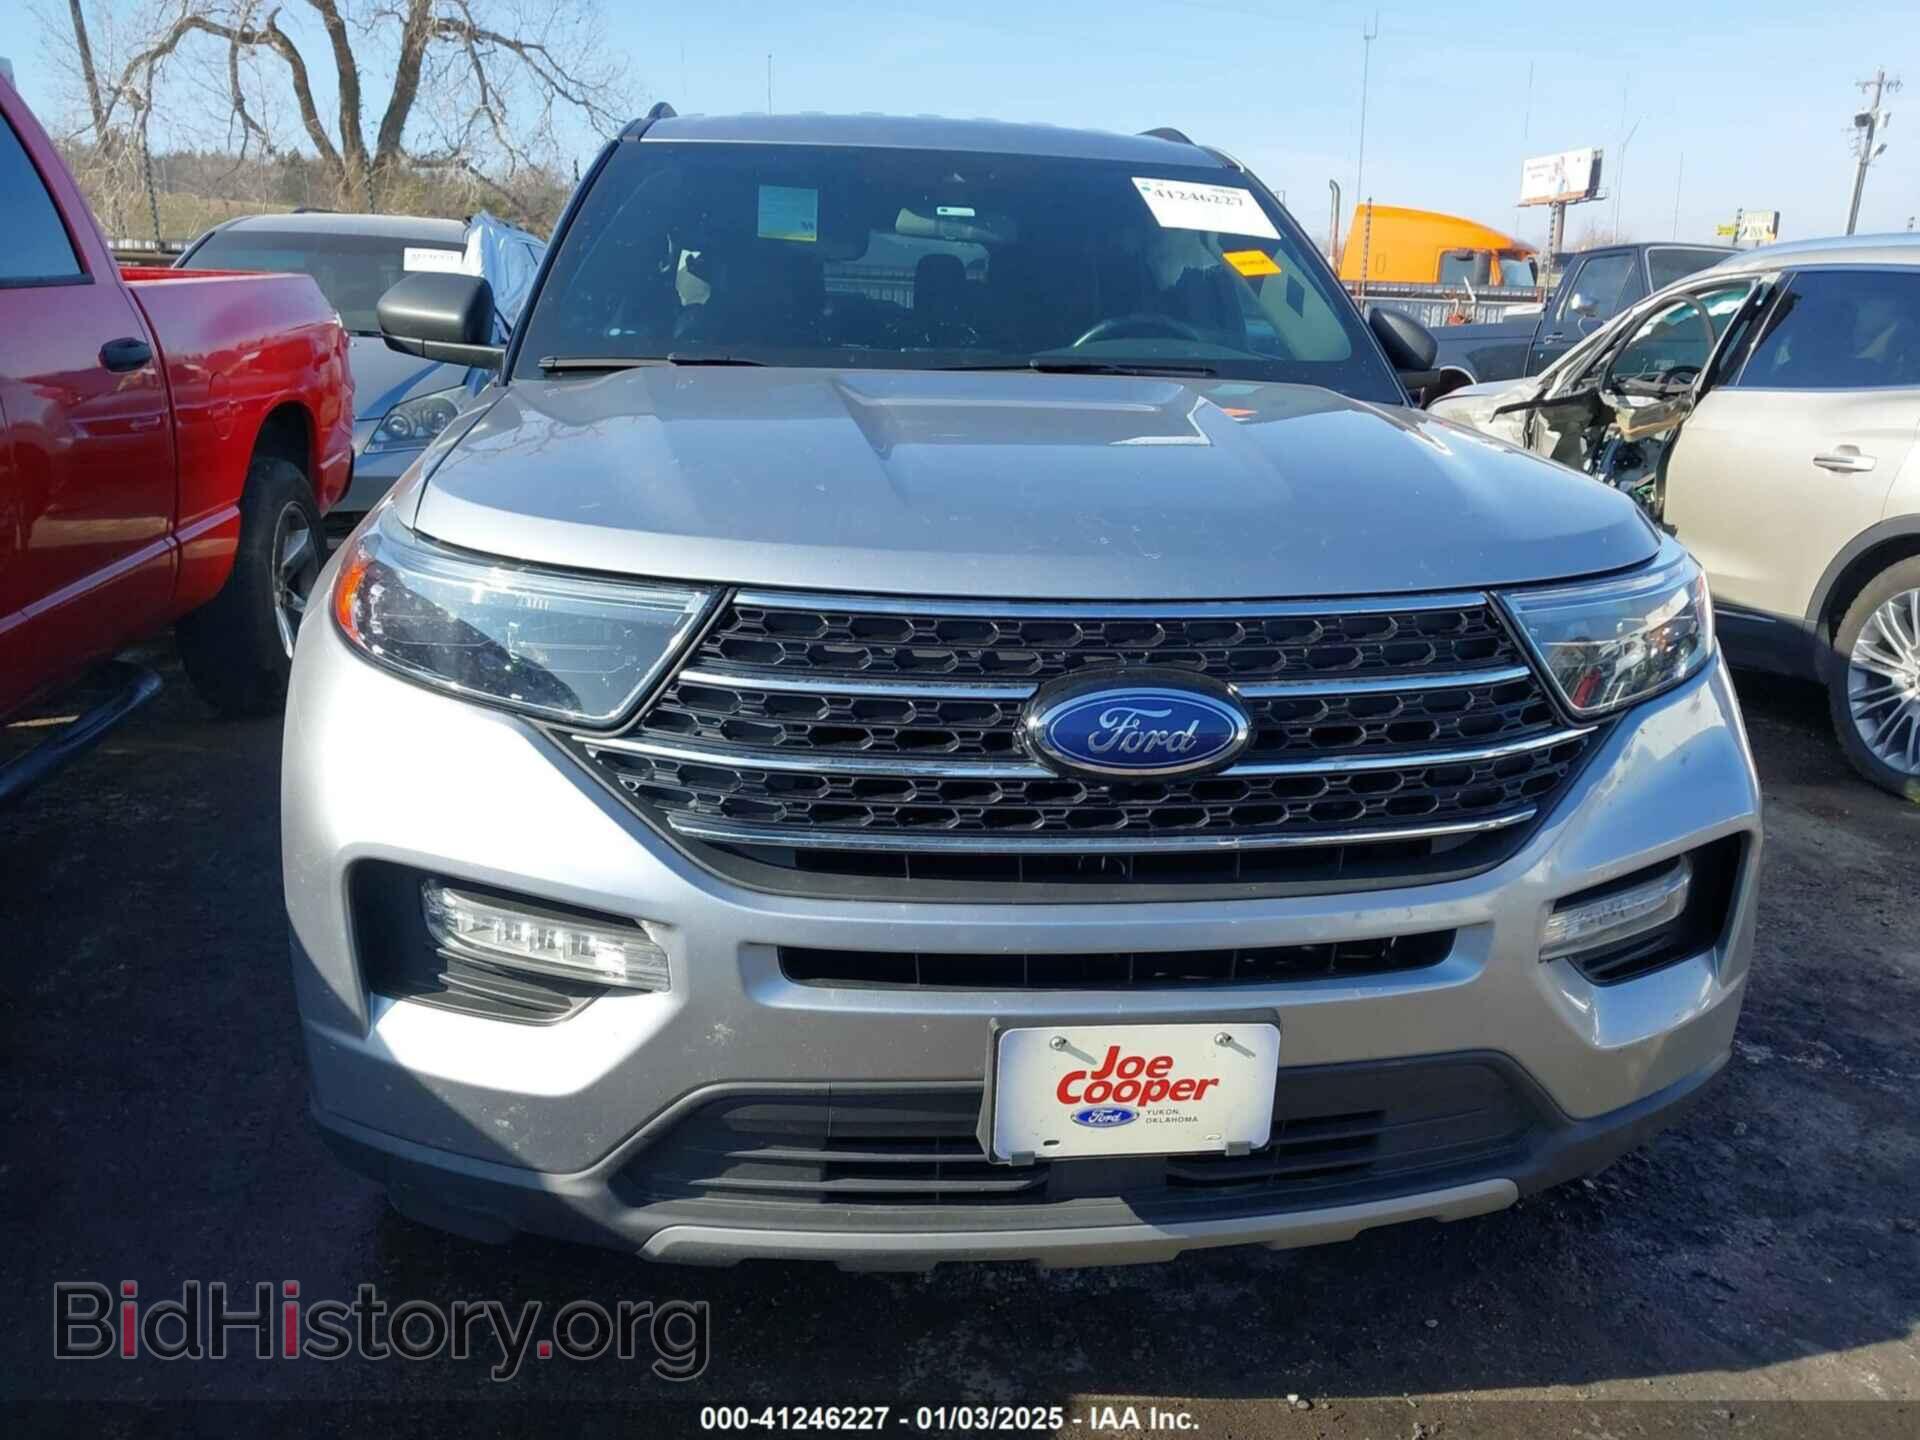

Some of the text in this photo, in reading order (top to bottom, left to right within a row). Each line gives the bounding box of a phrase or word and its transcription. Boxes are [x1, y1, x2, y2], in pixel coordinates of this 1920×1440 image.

[1088, 707, 1200, 754] Ford
[1091, 1045, 1174, 1080] Joe
[1056, 1070, 1219, 1107] Cooper
[1088, 1109, 1122, 1123] Ford
[1145, 1115, 1199, 1124] OKLAHOMA
